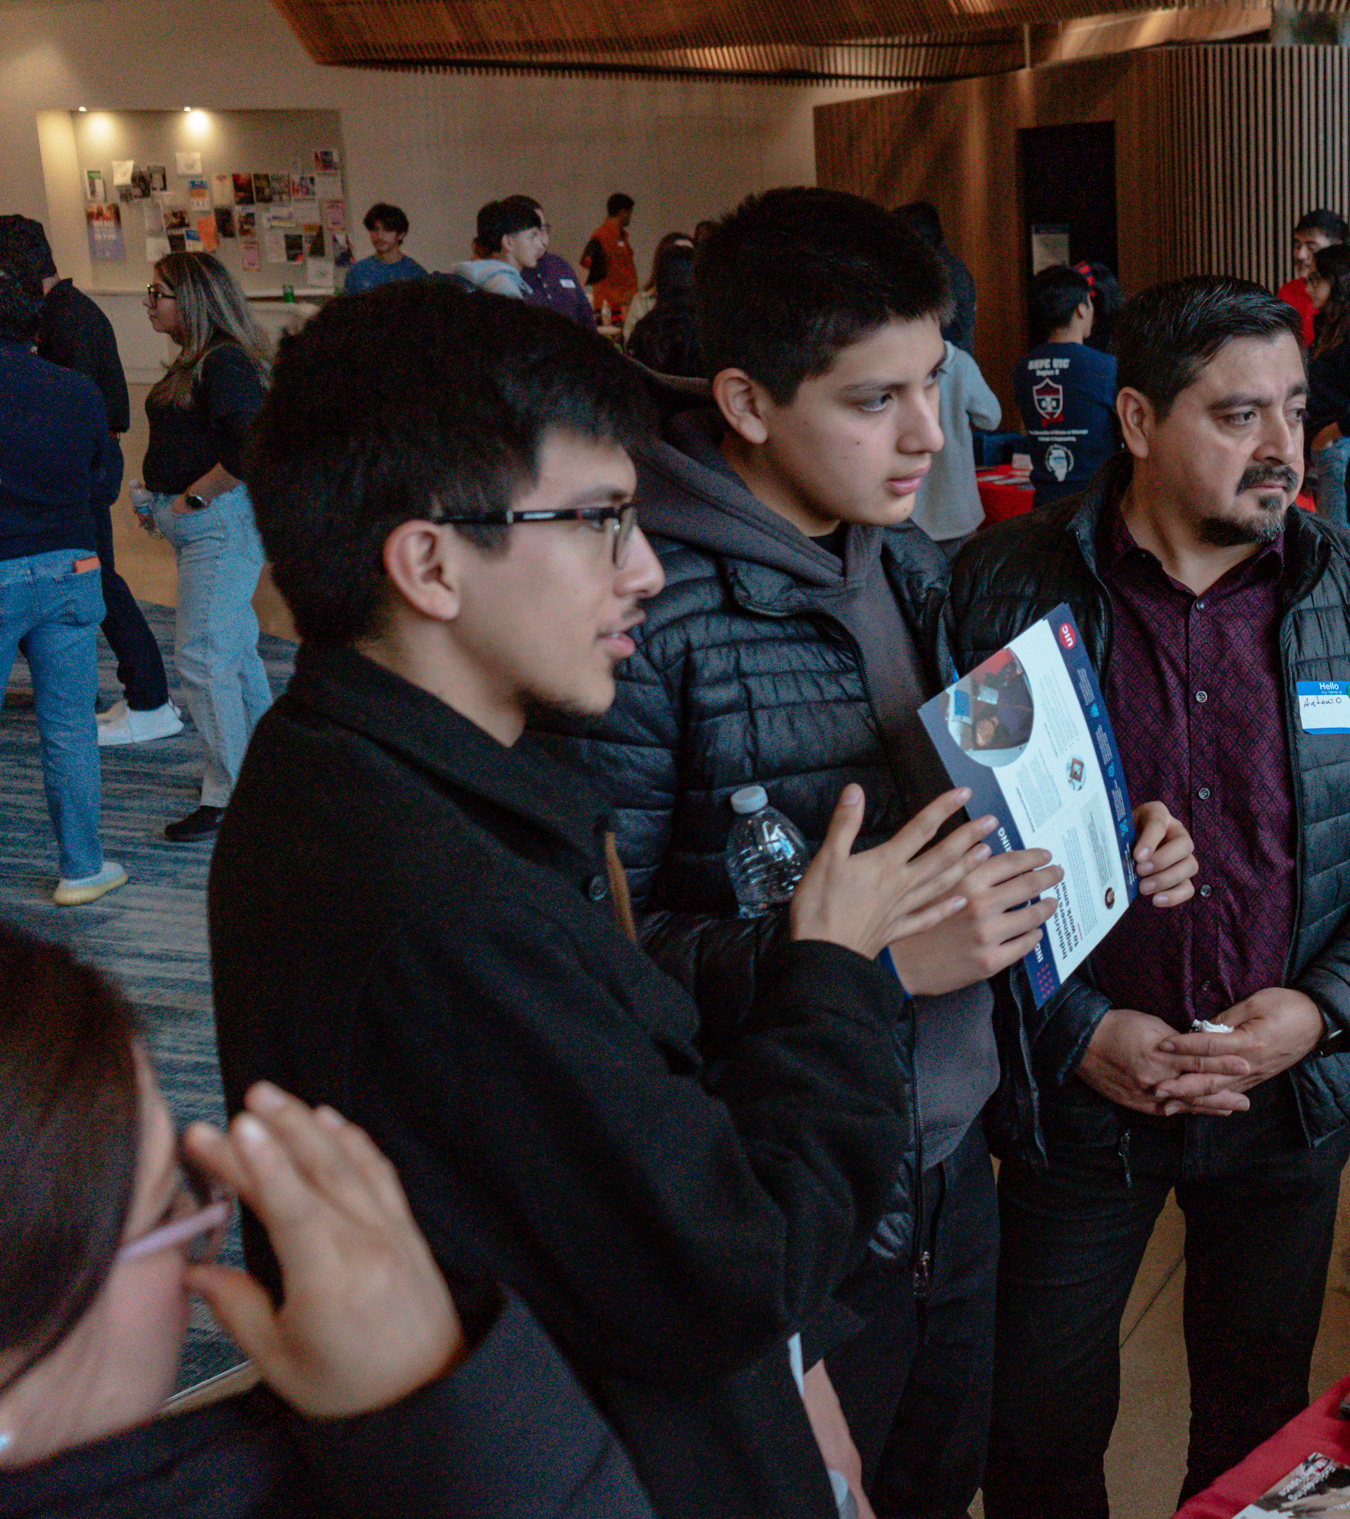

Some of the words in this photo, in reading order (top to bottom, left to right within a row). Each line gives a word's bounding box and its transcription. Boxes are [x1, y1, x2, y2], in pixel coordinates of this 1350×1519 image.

[1061, 625, 1074, 648] UIC
[1318, 682, 1340, 690] Hello
[1058, 900, 1074, 952] engineers
[1066, 909, 1077, 933] work
[1073, 936, 1080, 948] to
